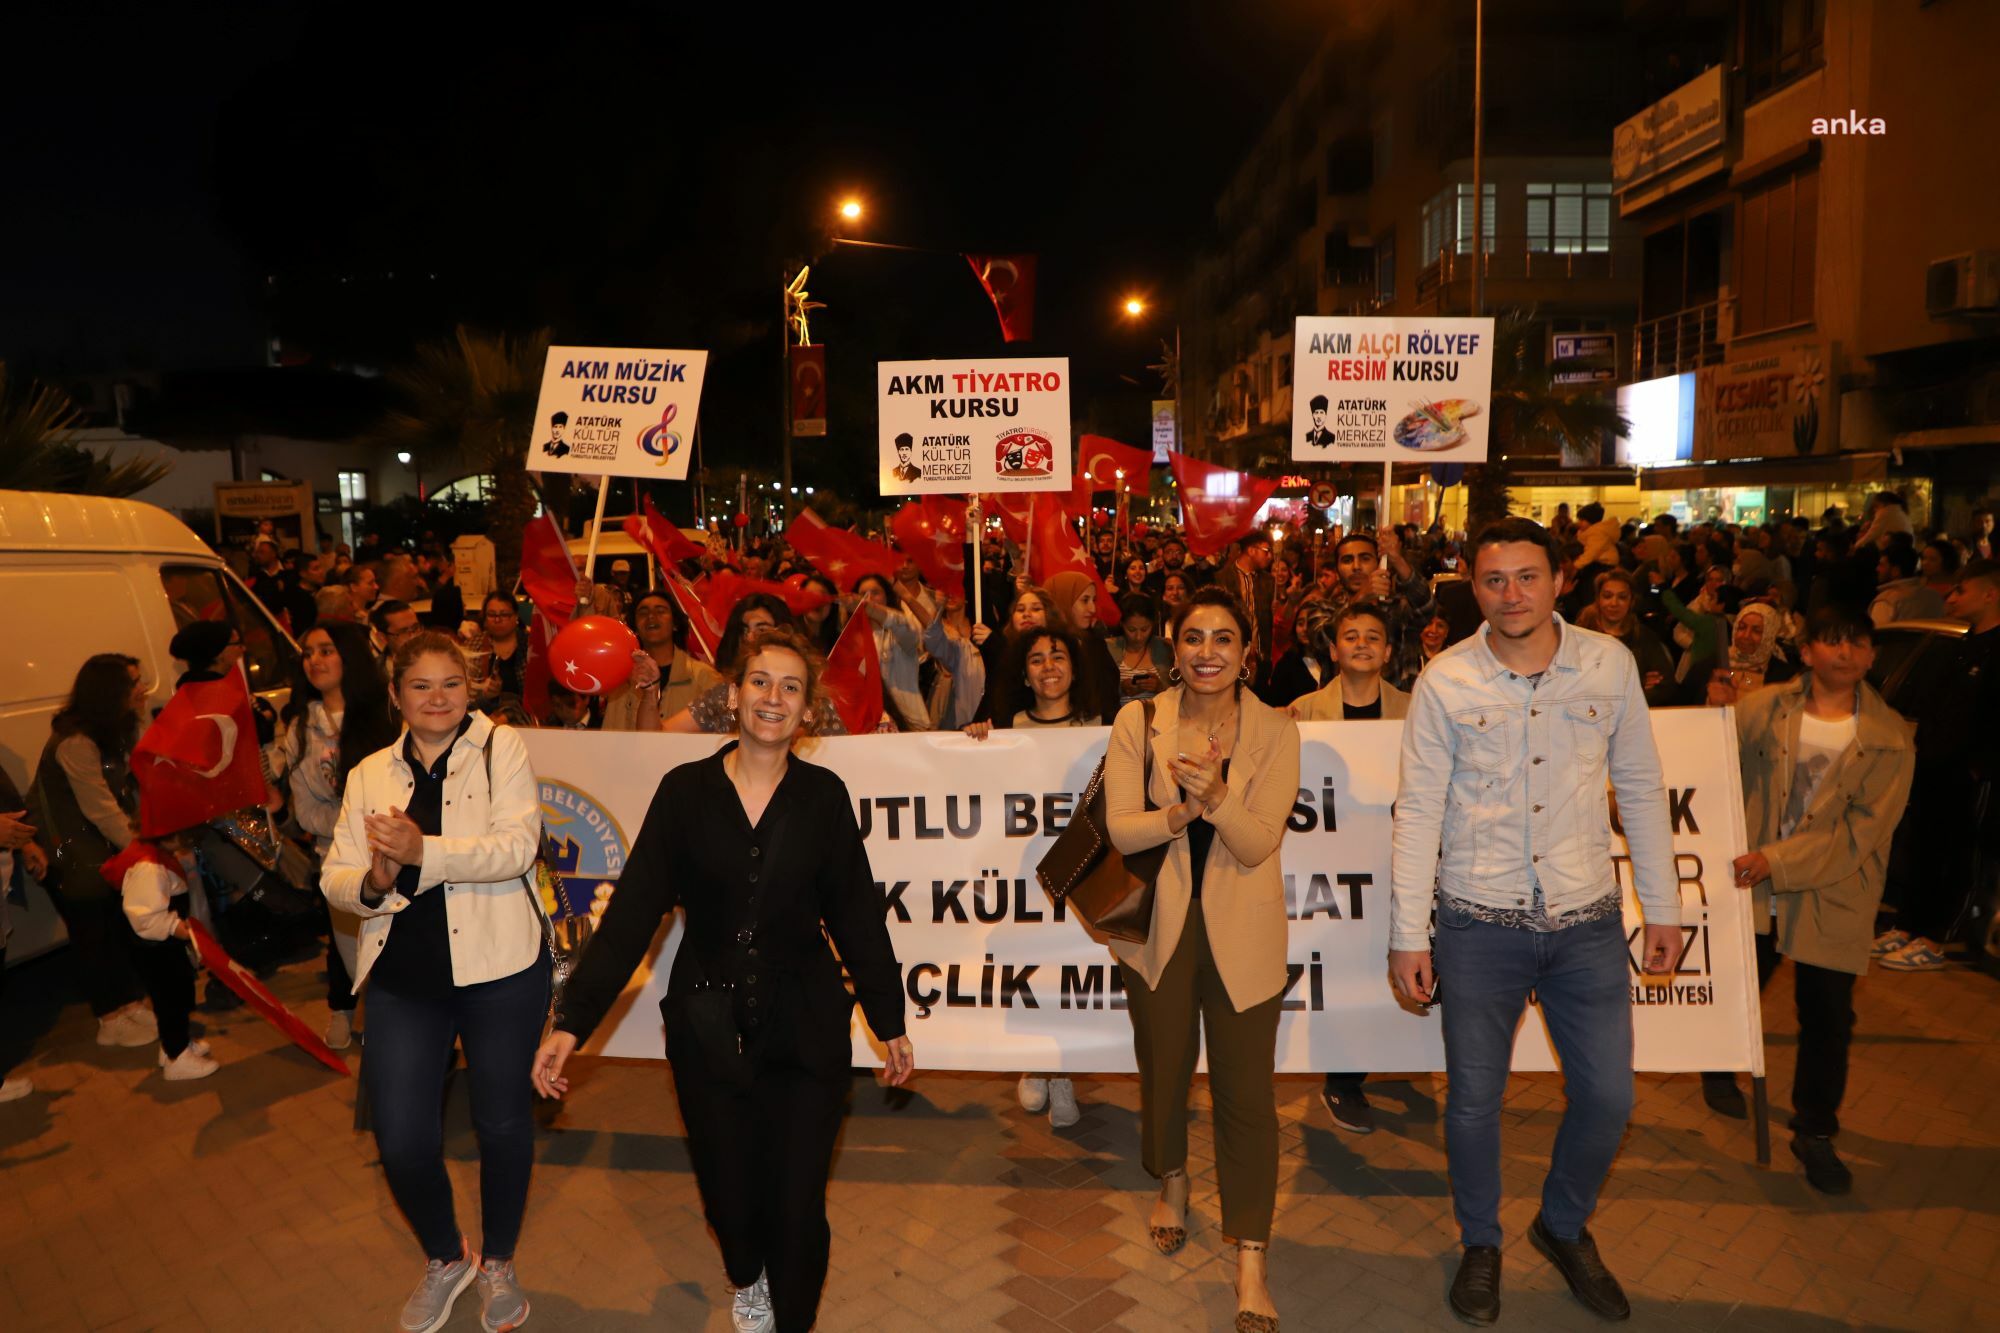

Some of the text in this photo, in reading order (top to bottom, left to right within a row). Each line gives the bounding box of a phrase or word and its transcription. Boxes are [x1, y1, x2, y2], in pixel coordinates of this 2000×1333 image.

[1309, 329, 1480, 360] AKM ALÇI RÖLYEF
[561, 359, 687, 382] AKM MÜZİK
[1328, 356, 1459, 381] RESİM KURSU
[888, 369, 1060, 395] AKM TİYATRO
[581, 384, 657, 405] KURSU
[931, 398, 1018, 418] KURSU
[1338, 398, 1386, 410] ATATÜRK
[576, 415, 622, 428] ATATÜRK
[1337, 411, 1386, 426] KÜLTÜR
[573, 427, 620, 441] KÜLTÜR
[922, 434, 970, 447] ATATÜRK
[1336, 428, 1386, 441] MERKEZİ
[922, 447, 970, 461] KÜLTÜR
[922, 461, 971, 475] MERKEZİ
[898, 953, 1040, 1019] ÇLİK
